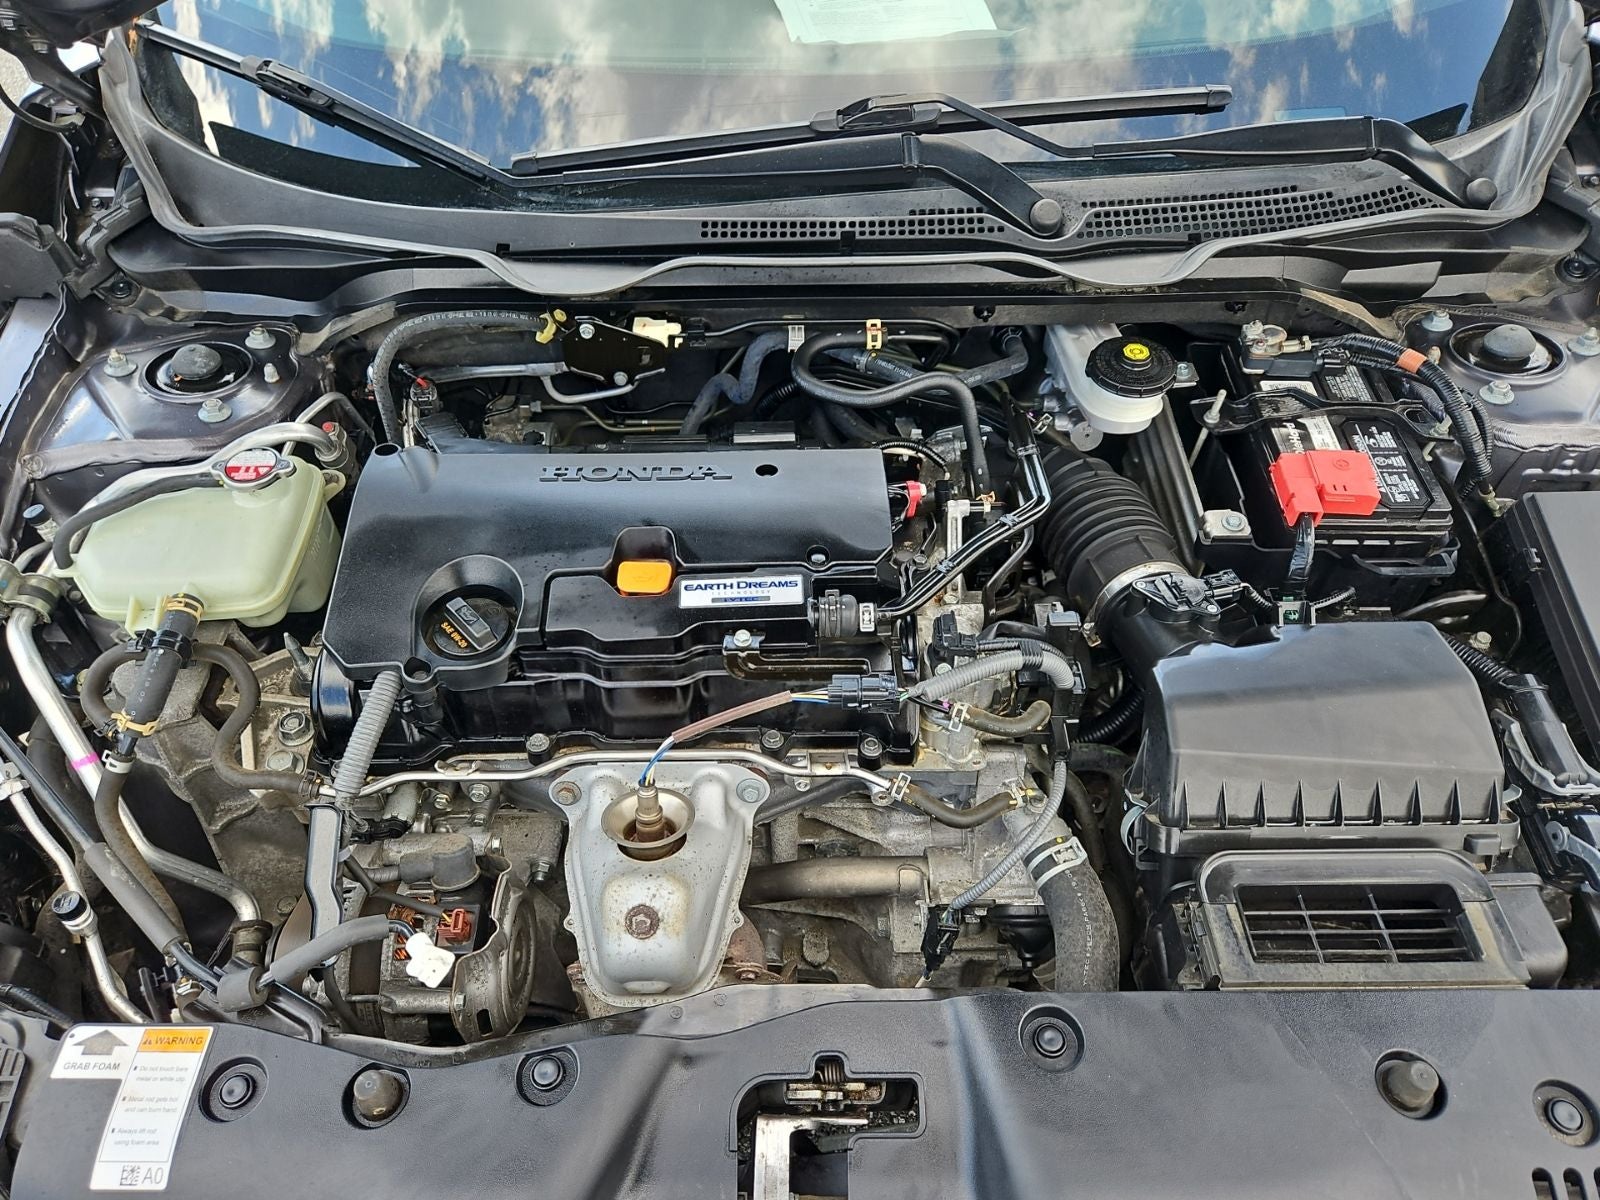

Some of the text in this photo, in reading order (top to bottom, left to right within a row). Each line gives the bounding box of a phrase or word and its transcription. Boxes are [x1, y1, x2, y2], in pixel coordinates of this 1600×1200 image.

[539, 464, 733, 482] HONDA
[684, 580, 799, 592] EARTH DREAMS
[440, 621, 468, 648] SAE 0W-20
[155, 1036, 203, 1046] WARNING
[63, 1062, 120, 1071] GRAB FOAM
